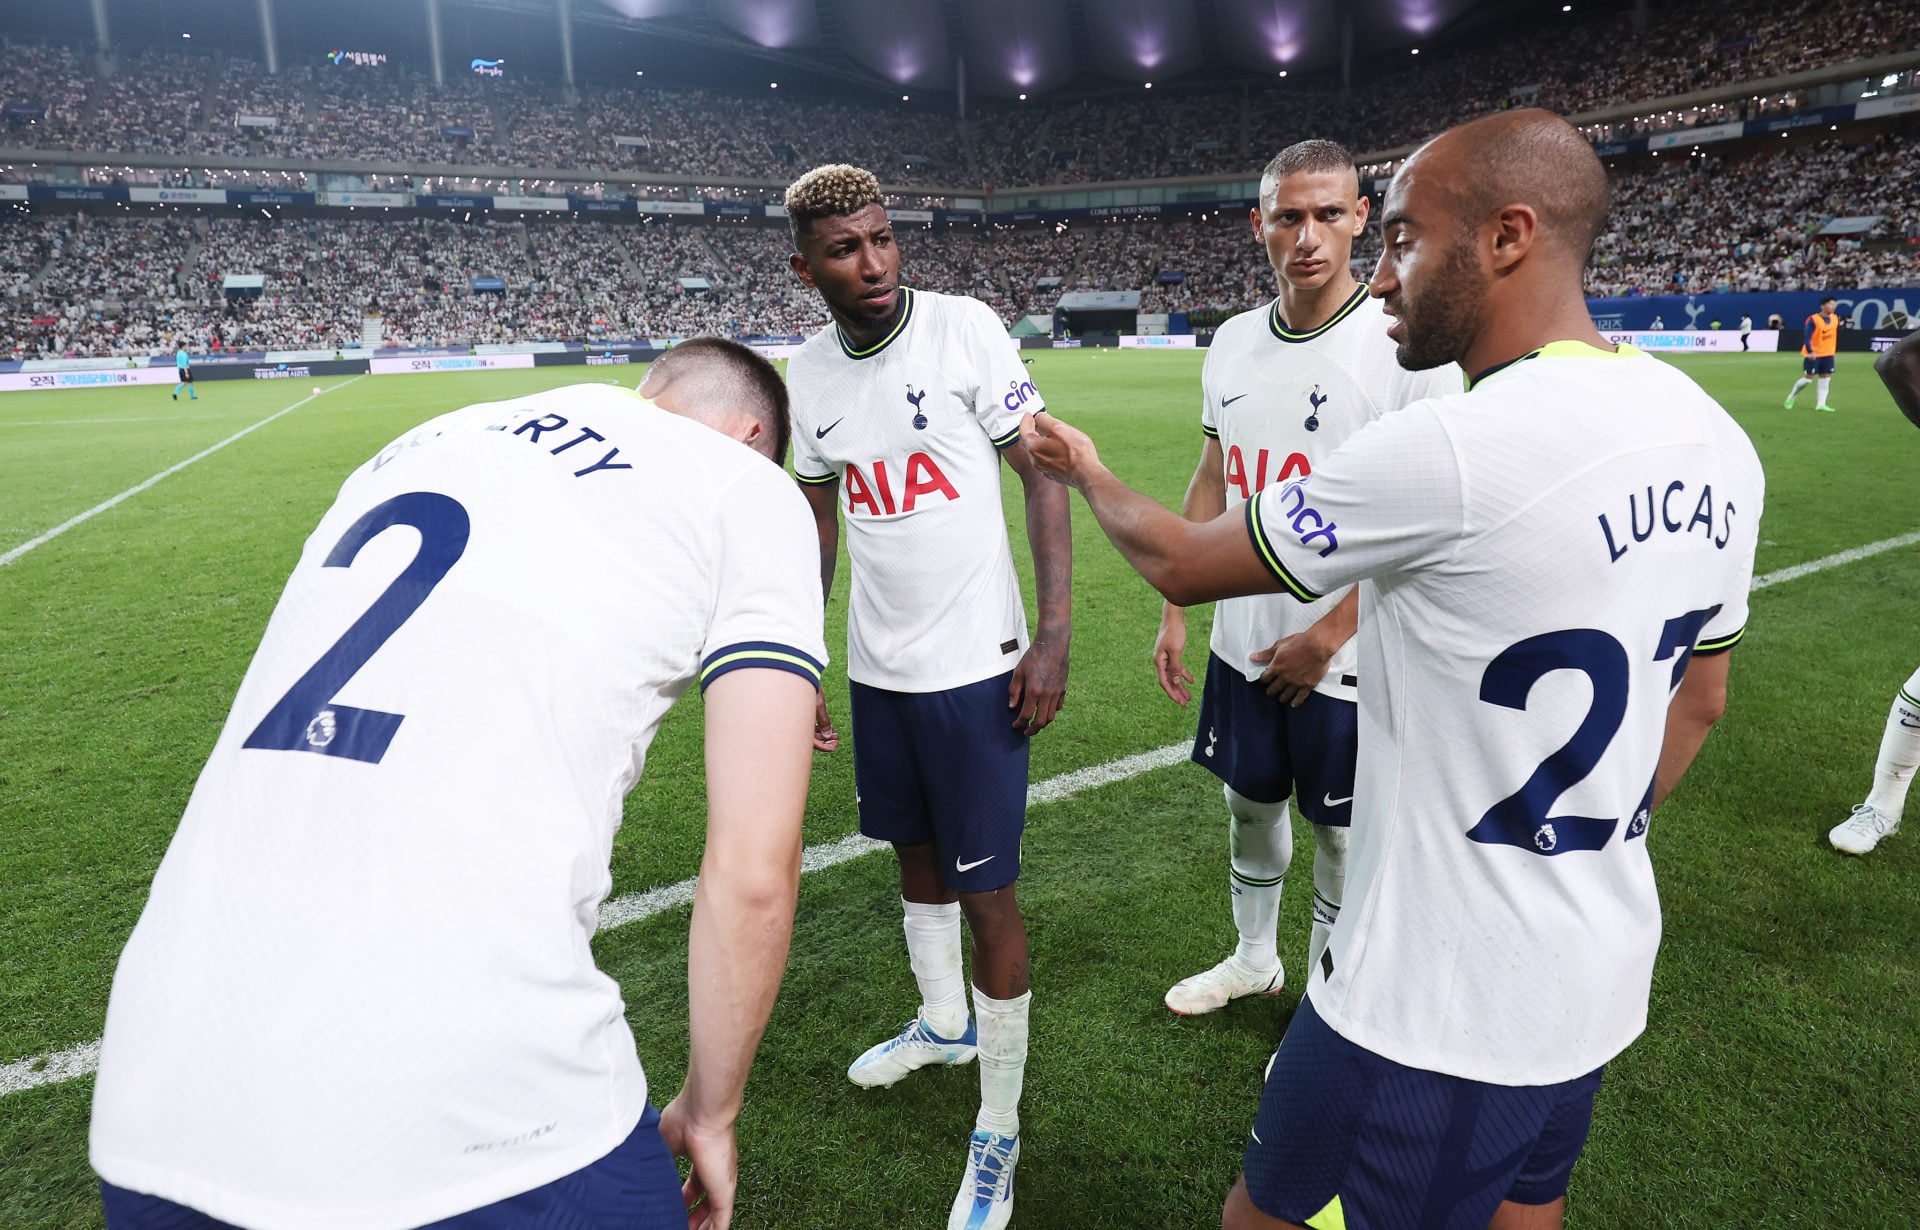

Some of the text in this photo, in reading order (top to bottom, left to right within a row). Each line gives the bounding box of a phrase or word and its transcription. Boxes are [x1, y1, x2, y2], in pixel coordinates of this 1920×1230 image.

[845, 451, 961, 516] AIA
[1597, 480, 1736, 564] LUCAS
[241, 491, 471, 765] 2
